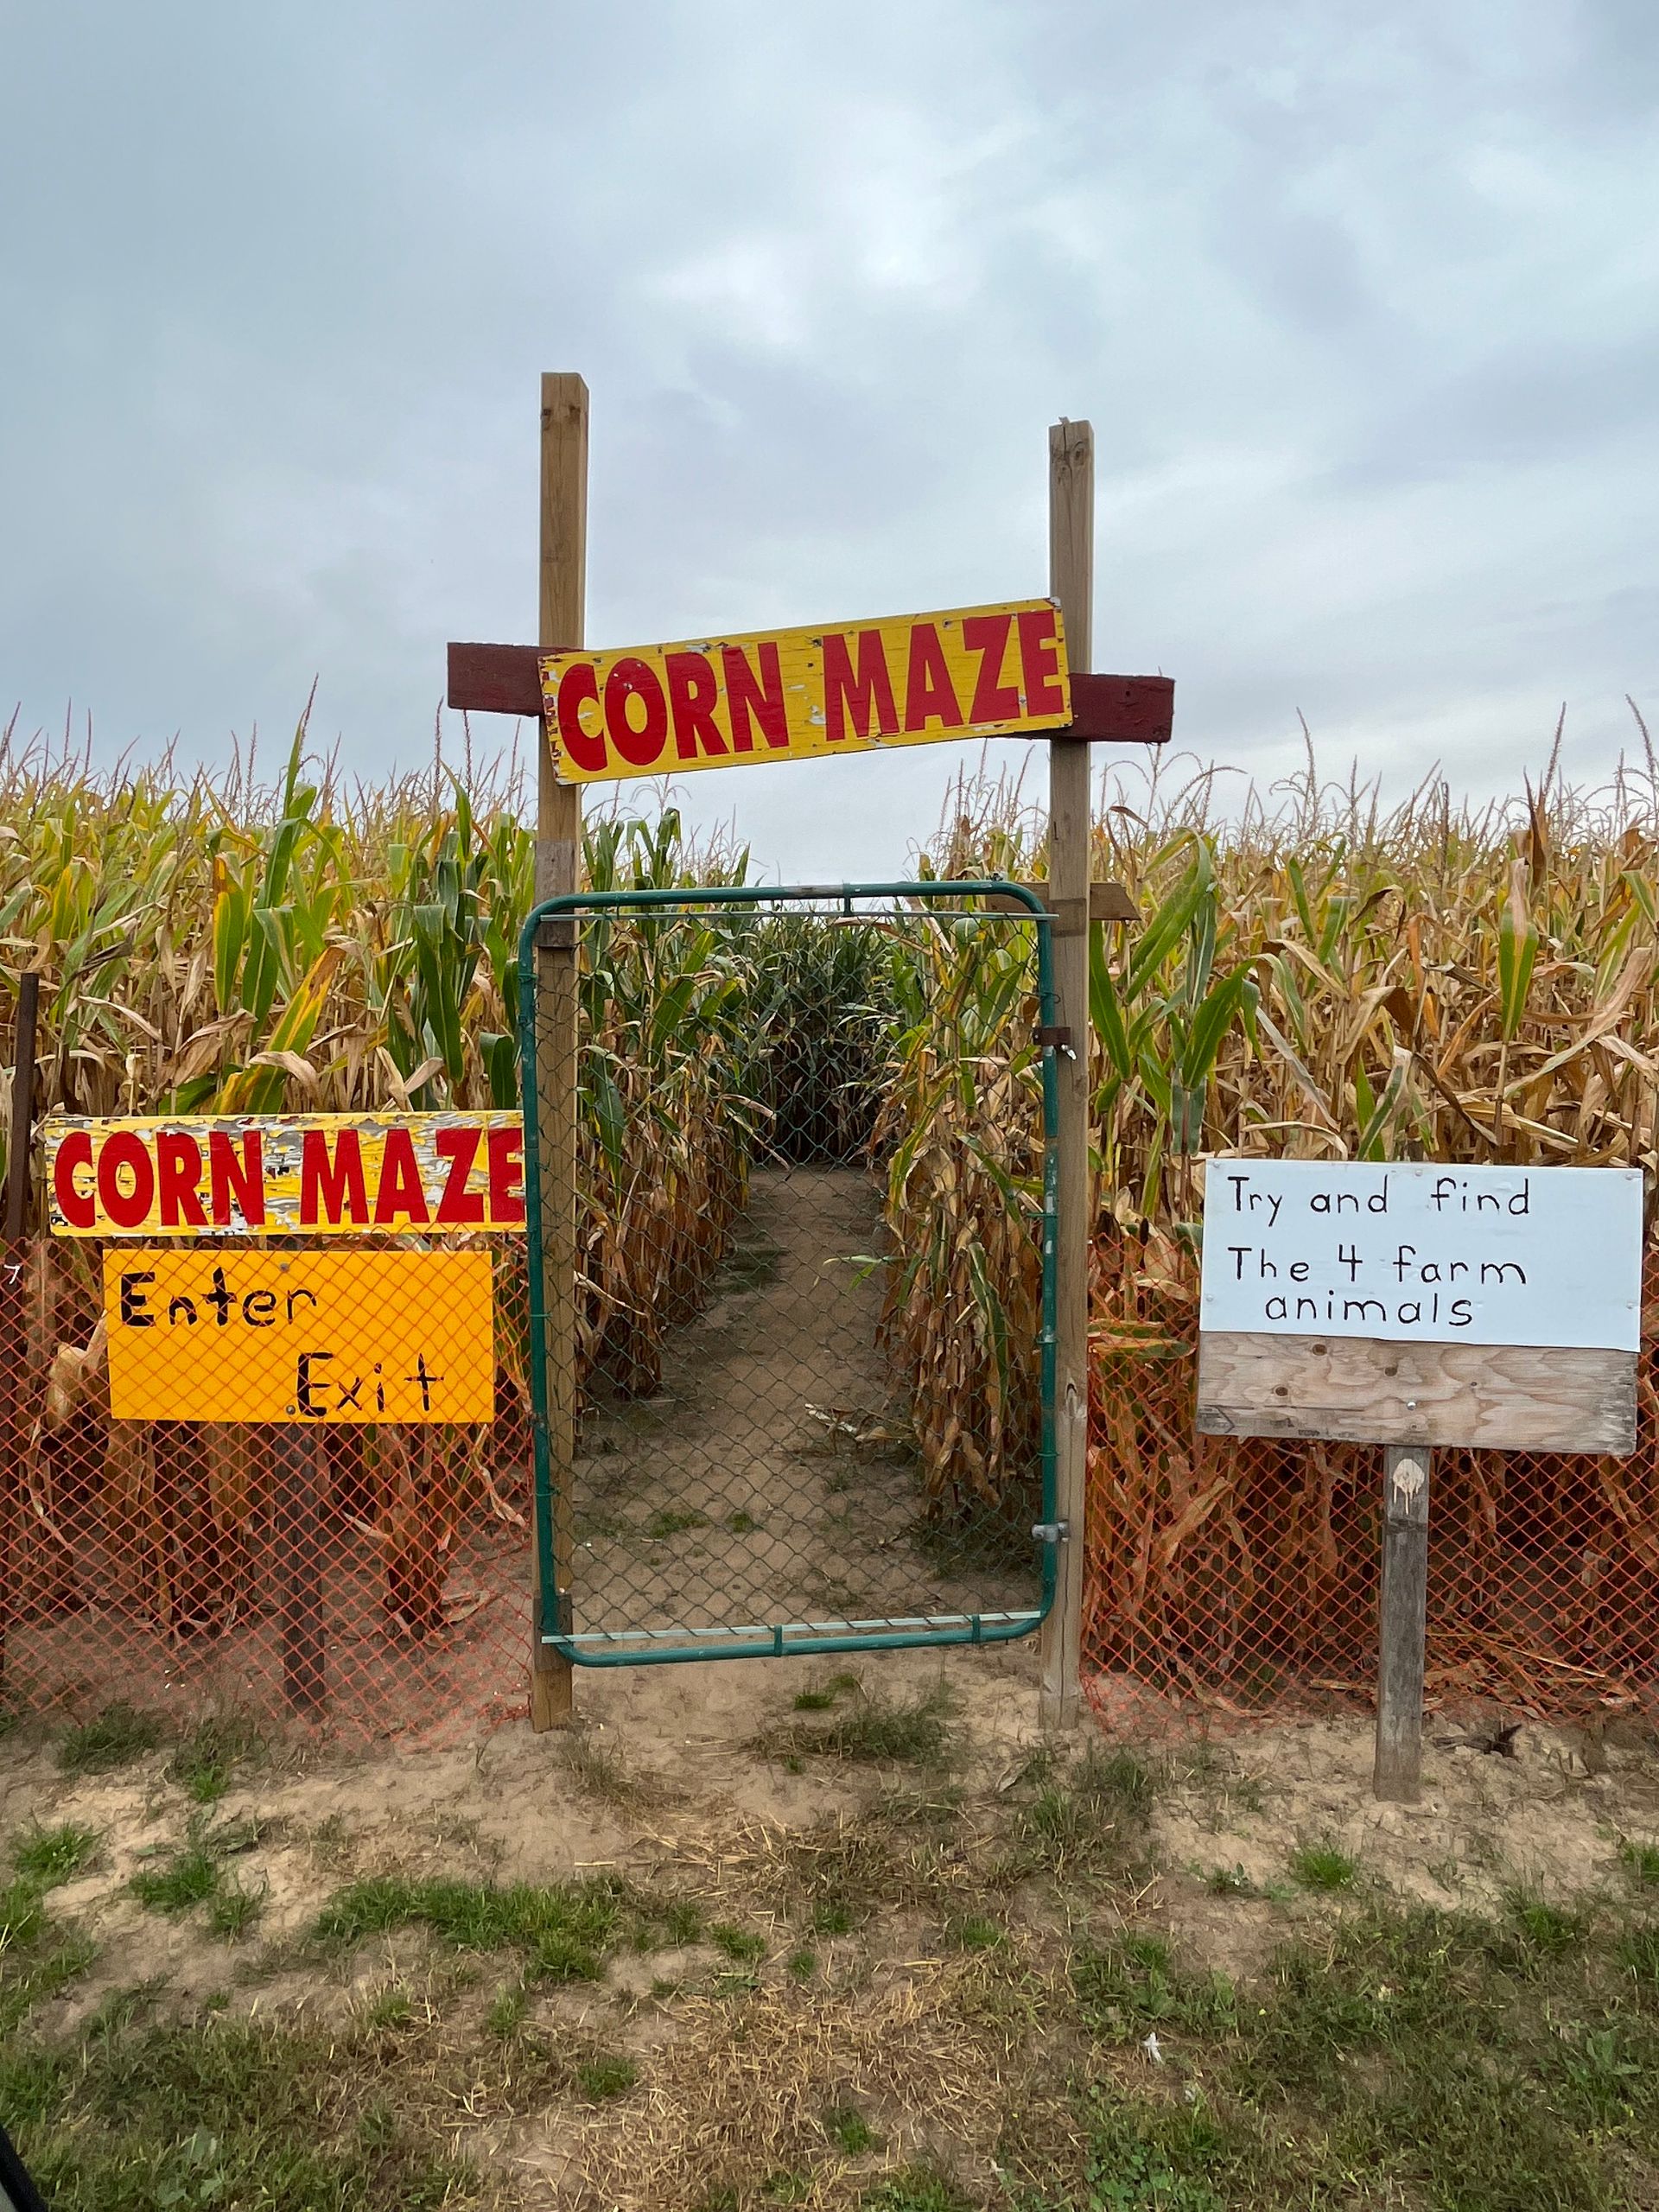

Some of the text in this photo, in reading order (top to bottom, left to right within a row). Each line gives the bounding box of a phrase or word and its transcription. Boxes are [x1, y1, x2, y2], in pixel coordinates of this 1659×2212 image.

[557, 608, 1065, 772] CORN MAZE
[54, 1127, 526, 1229] CORN MAZE
[1227, 1173, 1530, 1228] Try and find
[1227, 1244, 1528, 1286] The 4 farm
[119, 1266, 318, 1328] Enter
[1264, 1289, 1474, 1327] animals
[296, 1351, 445, 1418] Exit
